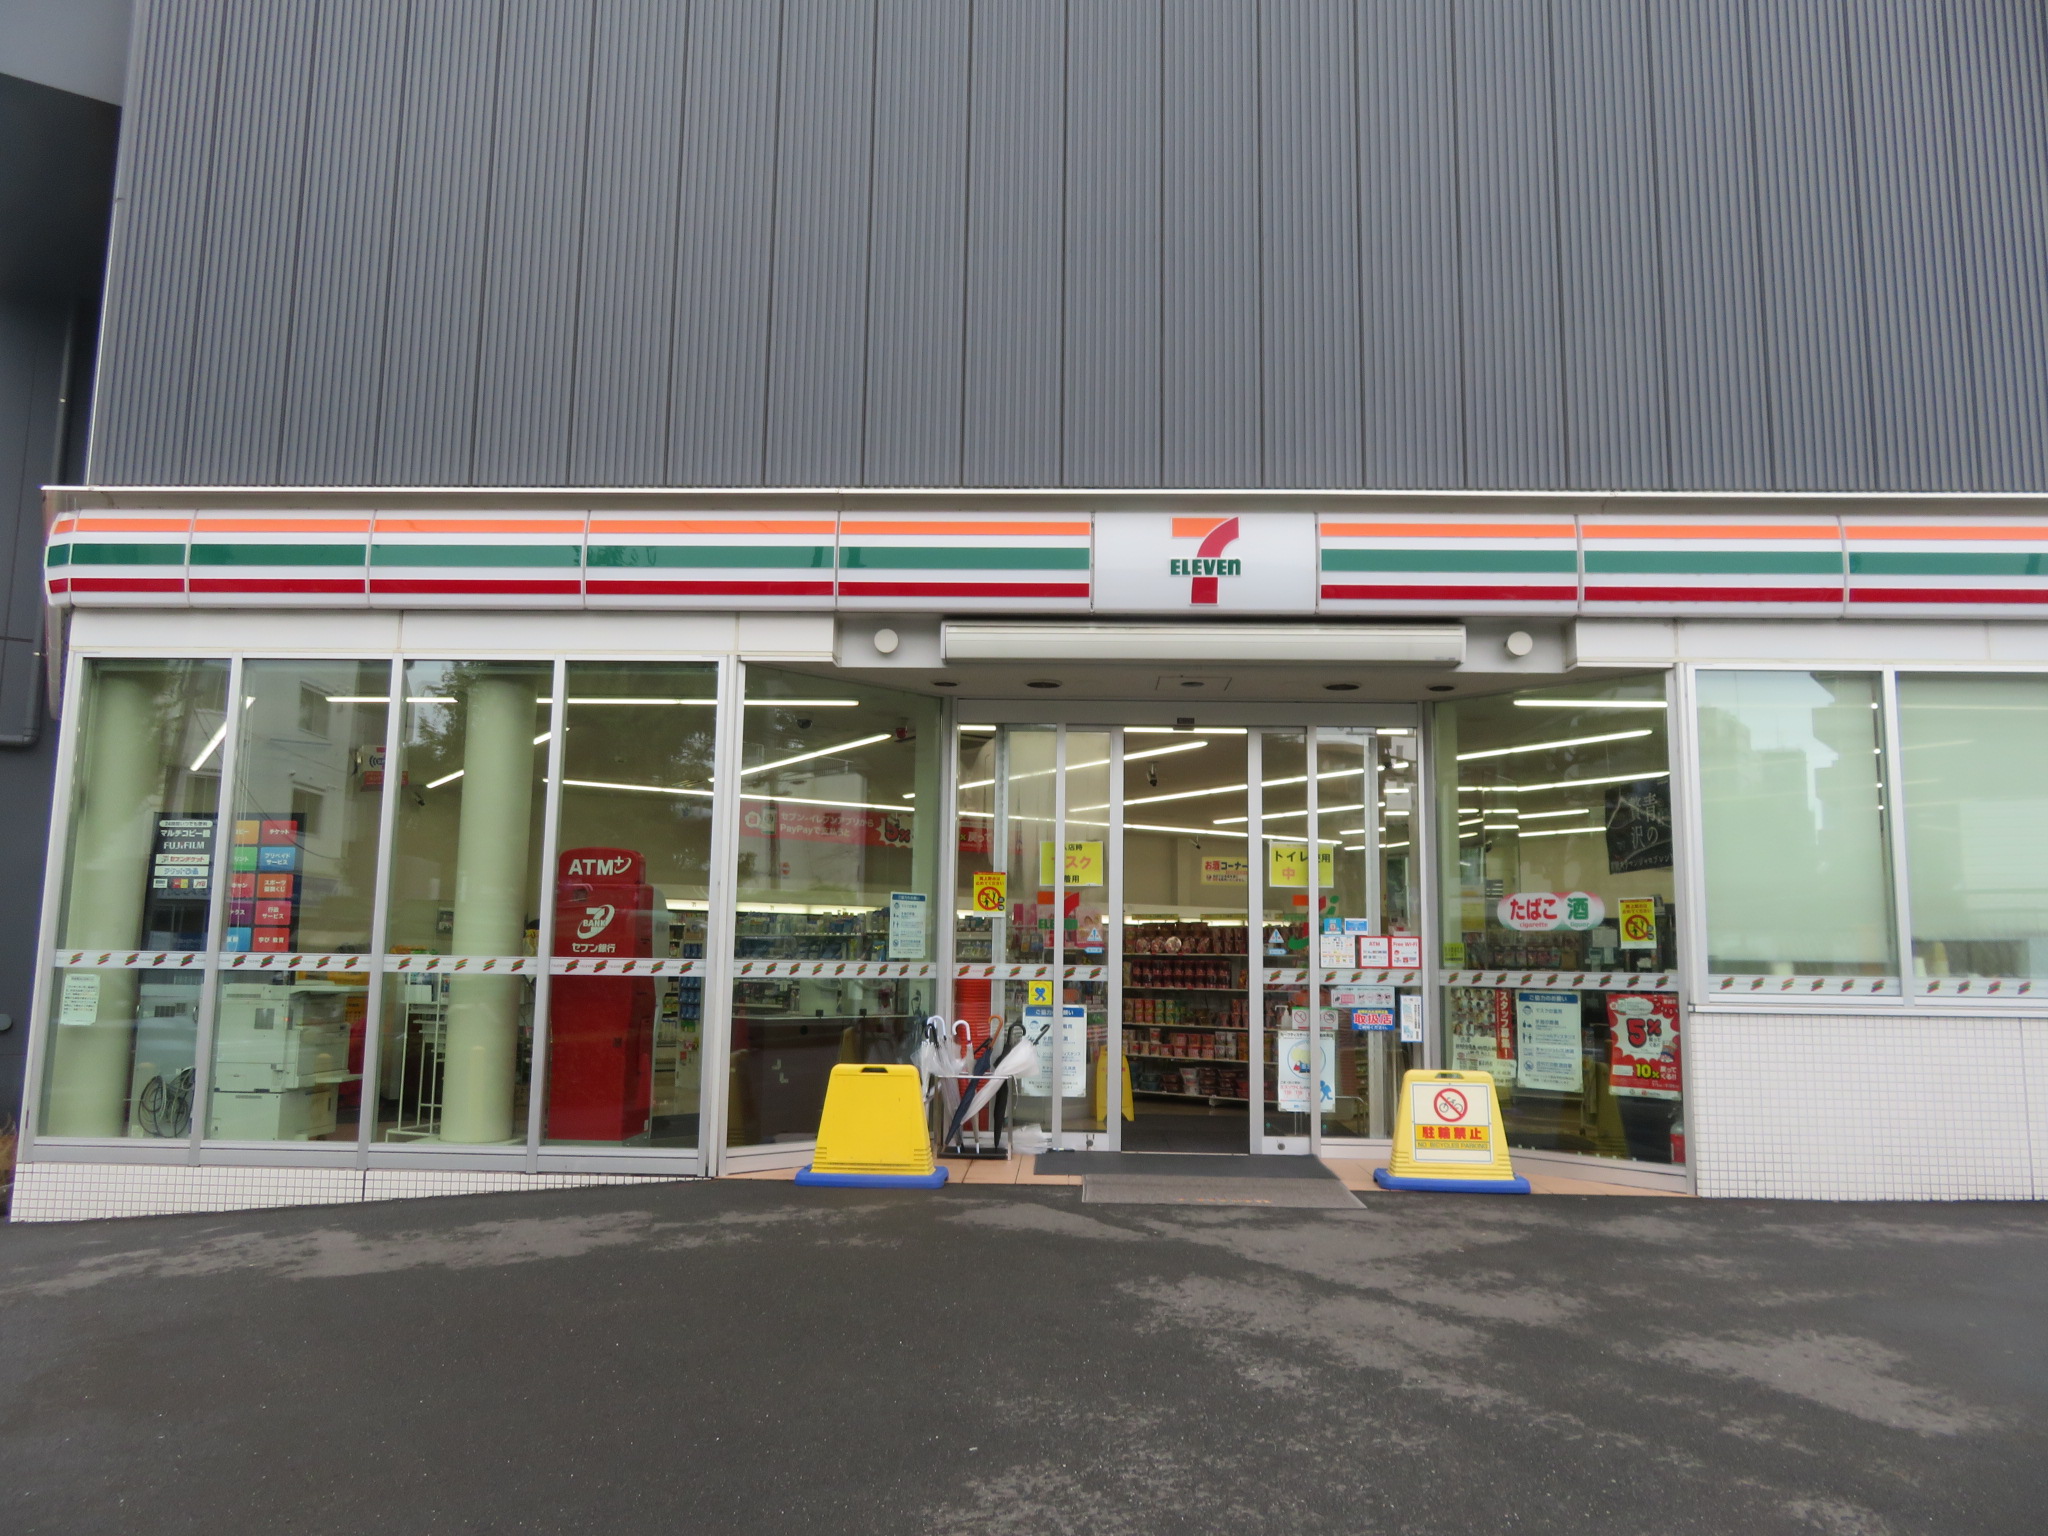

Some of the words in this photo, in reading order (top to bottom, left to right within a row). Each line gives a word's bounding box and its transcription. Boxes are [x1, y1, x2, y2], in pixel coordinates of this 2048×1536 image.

[1172, 517, 1239, 604] 7
[1064, 843, 1083, 851] 店時
[1275, 850, 1331, 863] トイレ用
[1510, 898, 1558, 920] たばこ
[1567, 897, 1589, 920] 酒
[572, 942, 616, 953] セブン銀行
[1354, 1013, 1393, 1025] 取扱店
[1422, 1126, 1482, 1140] 駐輪禁止
